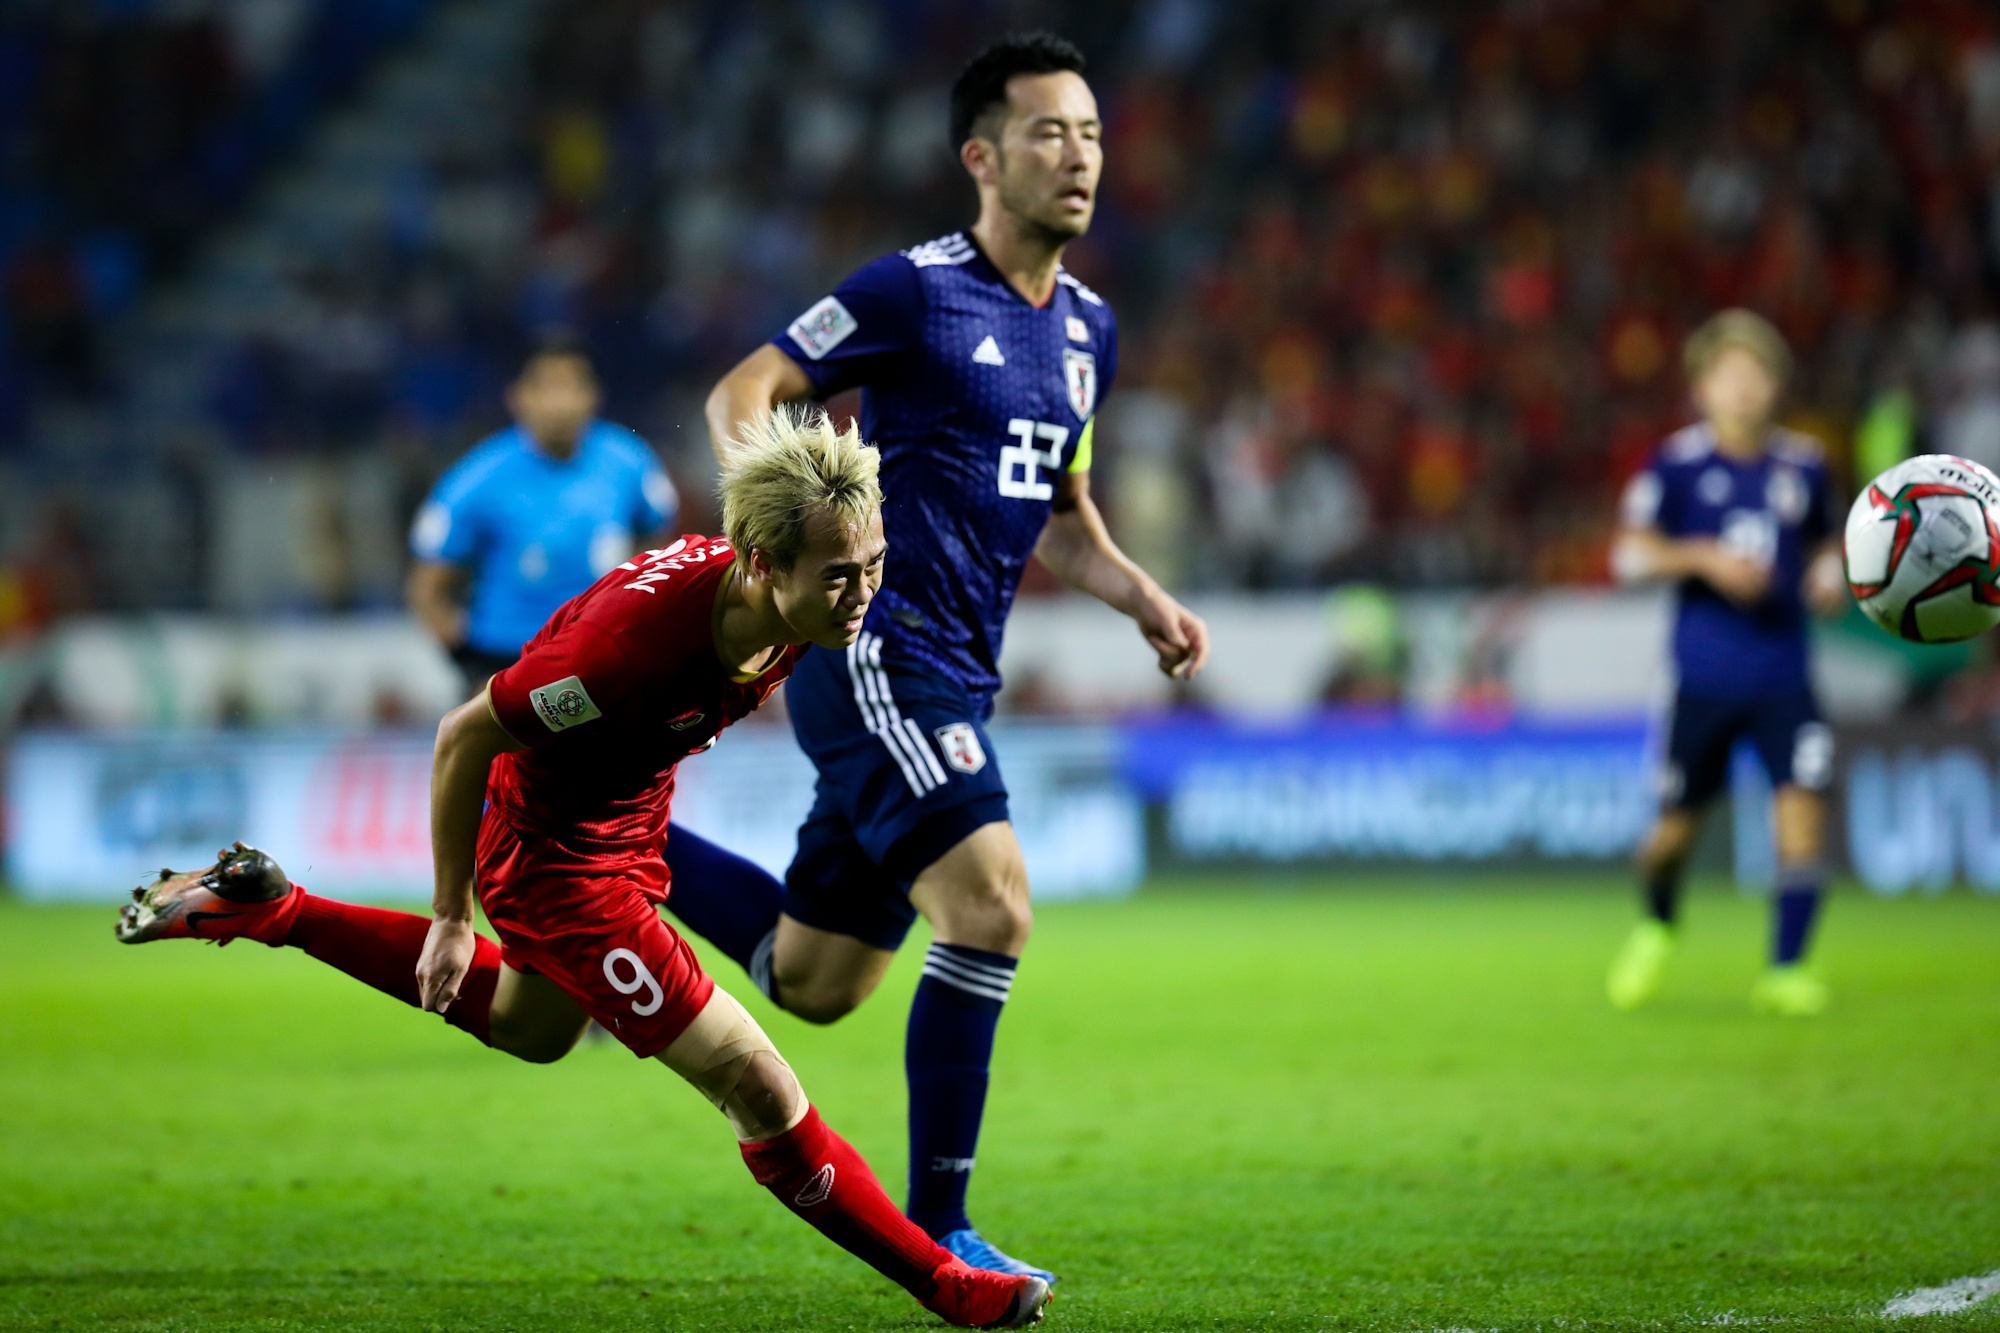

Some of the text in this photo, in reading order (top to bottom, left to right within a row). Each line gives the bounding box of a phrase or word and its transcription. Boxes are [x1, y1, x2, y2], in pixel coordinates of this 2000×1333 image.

[998, 418, 1070, 501] 22
[539, 692, 555, 716] ASIAN
[602, 947, 664, 1017] 9
